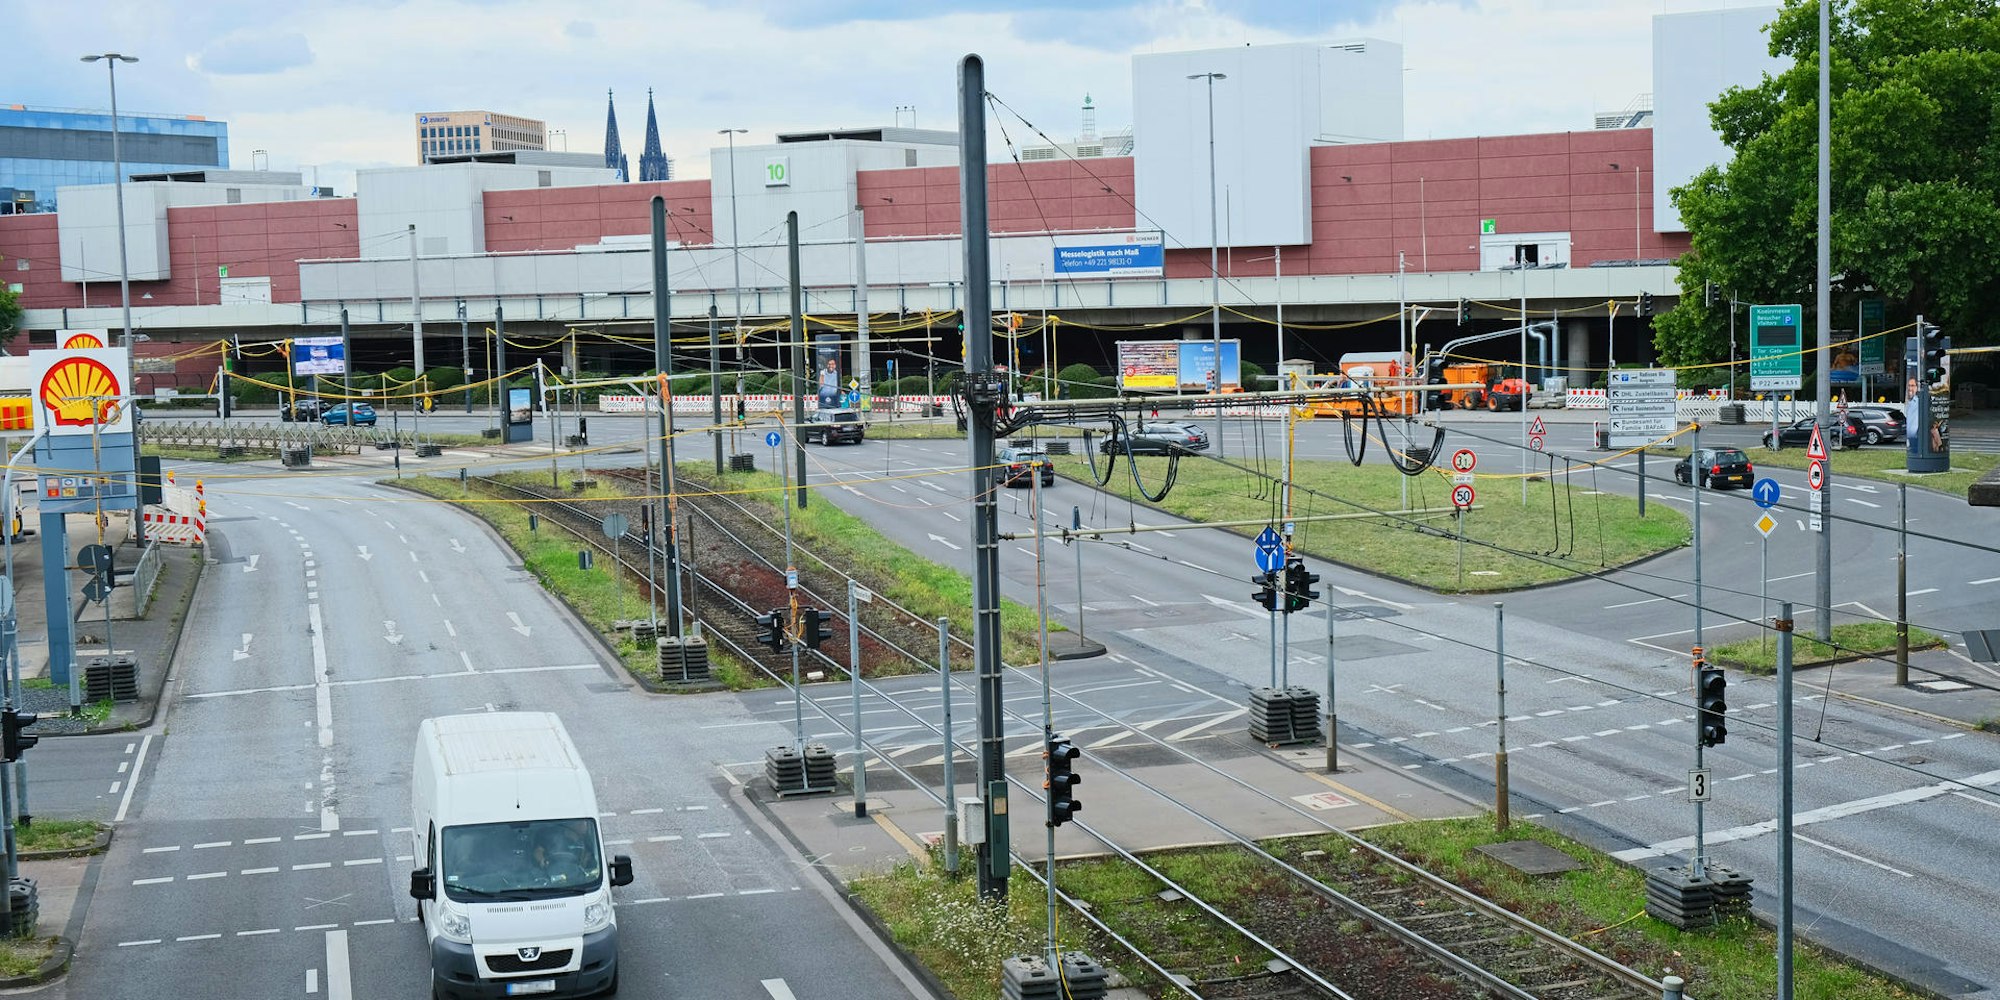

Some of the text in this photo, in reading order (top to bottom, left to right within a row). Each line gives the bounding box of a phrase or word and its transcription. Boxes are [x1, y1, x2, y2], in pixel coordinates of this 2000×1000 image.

[767, 164, 785, 180] 10
[1061, 248, 1139, 258] Messelogistik nach Maß
[1457, 490, 1470, 502] 50
[1695, 774, 1704, 797] 3
